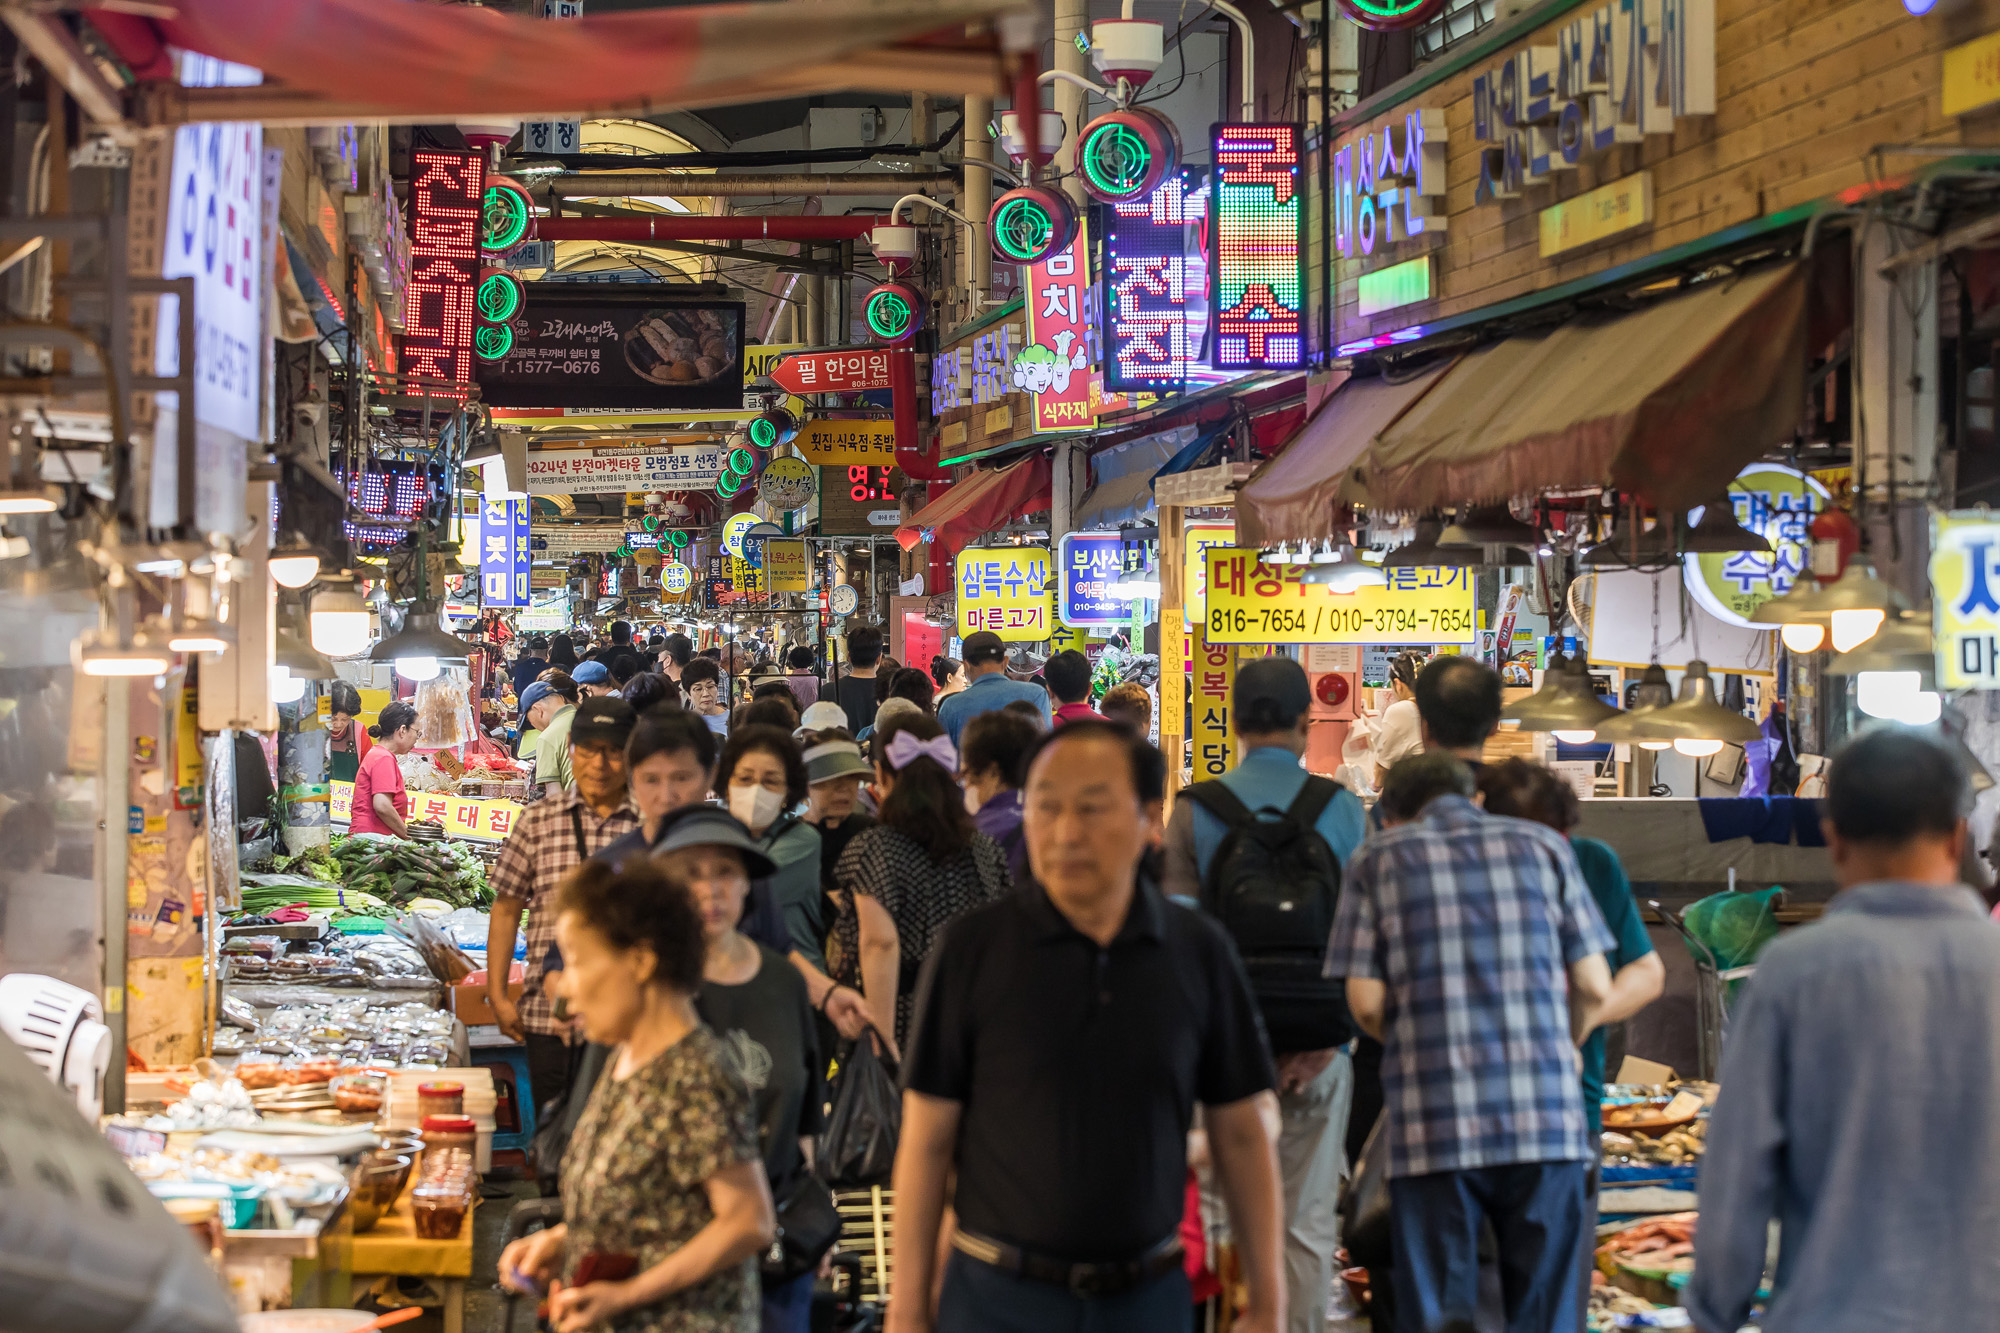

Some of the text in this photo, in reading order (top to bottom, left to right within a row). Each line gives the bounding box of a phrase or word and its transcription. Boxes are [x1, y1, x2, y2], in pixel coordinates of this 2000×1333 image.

[1334, 108, 1424, 259] 대성수산
[539, 319, 619, 341] 고래사어묵
[539, 349, 567, 359] 두꺼비
[569, 349, 588, 359] 쉼터
[591, 349, 600, 359] 옆
[797, 354, 888, 384] 필 한의원
[851, 379, 889, 388] 806-1075
[1043, 402, 1088, 424] 식자재
[572, 457, 641, 475] 부전마켓타운
[694, 454, 717, 469] 선정
[485, 499, 508, 600] 전봇대
[516, 499, 527, 600] 전봇대
[666, 567, 685, 578] 진주
[667, 578, 686, 588] 상회
[962, 560, 1046, 599] 삼득수산
[1213, 556, 1356, 597] 대성수
[1726, 549, 1808, 592] 수산
[967, 606, 1043, 631] 마른고기
[1211, 608, 1306, 633] 816-7654
[1313, 606, 1322, 634] /
[1330, 608, 1472, 633] 010-3794-7654
[1200, 638, 1231, 775] 행복식당
[332, 799, 347, 813] 각종
